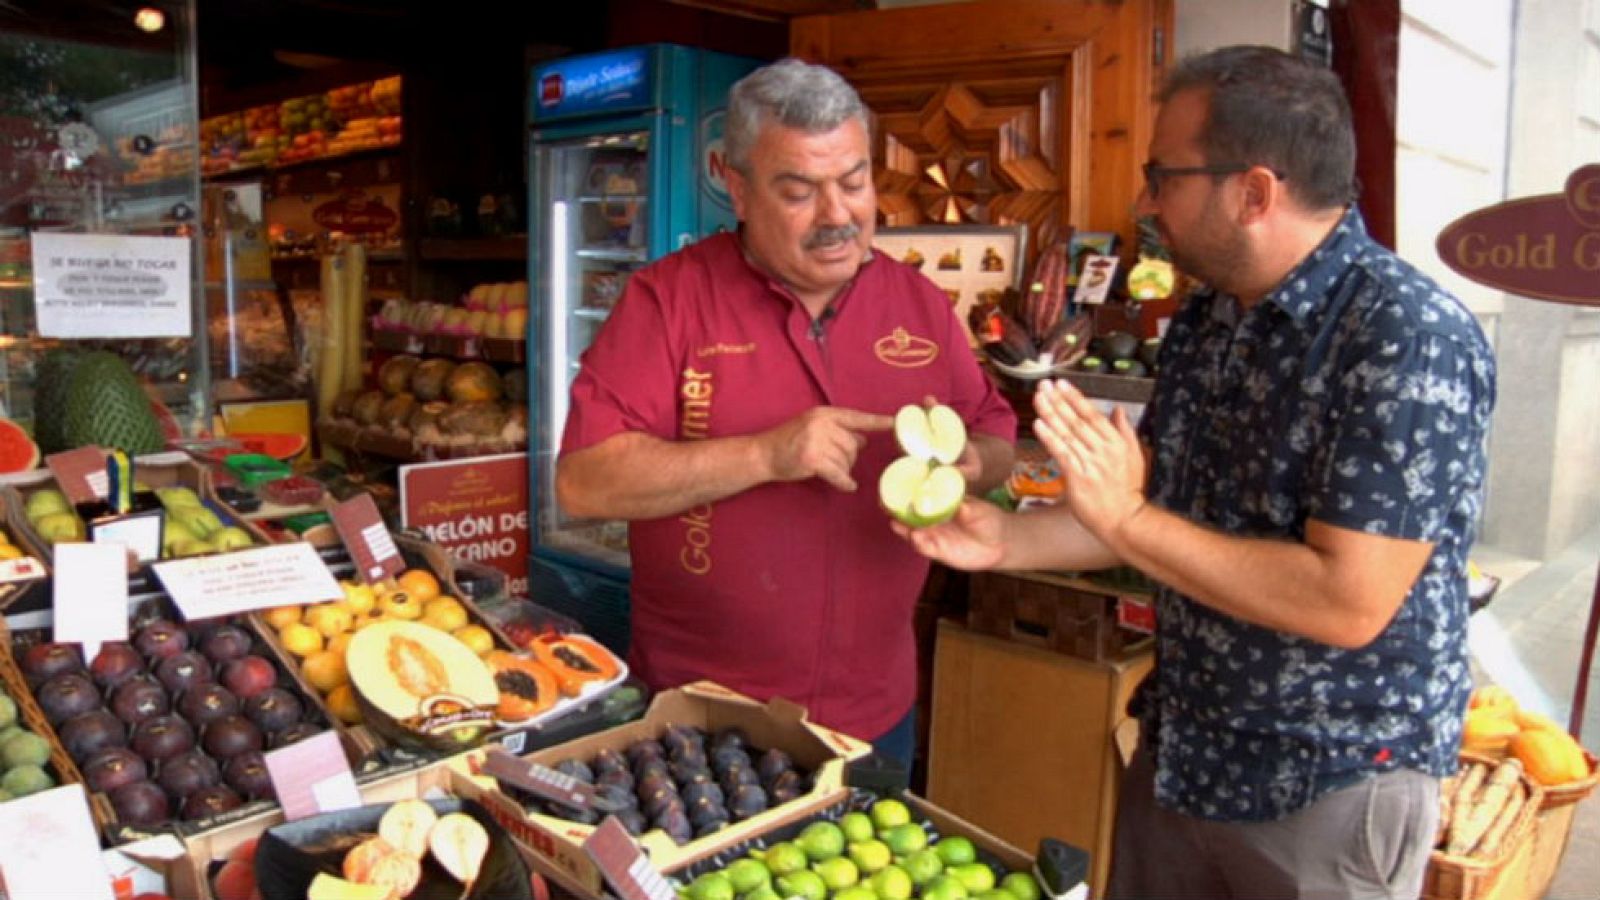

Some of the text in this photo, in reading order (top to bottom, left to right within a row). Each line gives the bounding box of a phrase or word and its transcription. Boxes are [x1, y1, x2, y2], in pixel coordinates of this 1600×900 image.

[1456, 232, 1556, 269] Gold
[682, 367, 713, 438] rmet
[499, 510, 527, 532] DE
[448, 536, 517, 561] CANO
